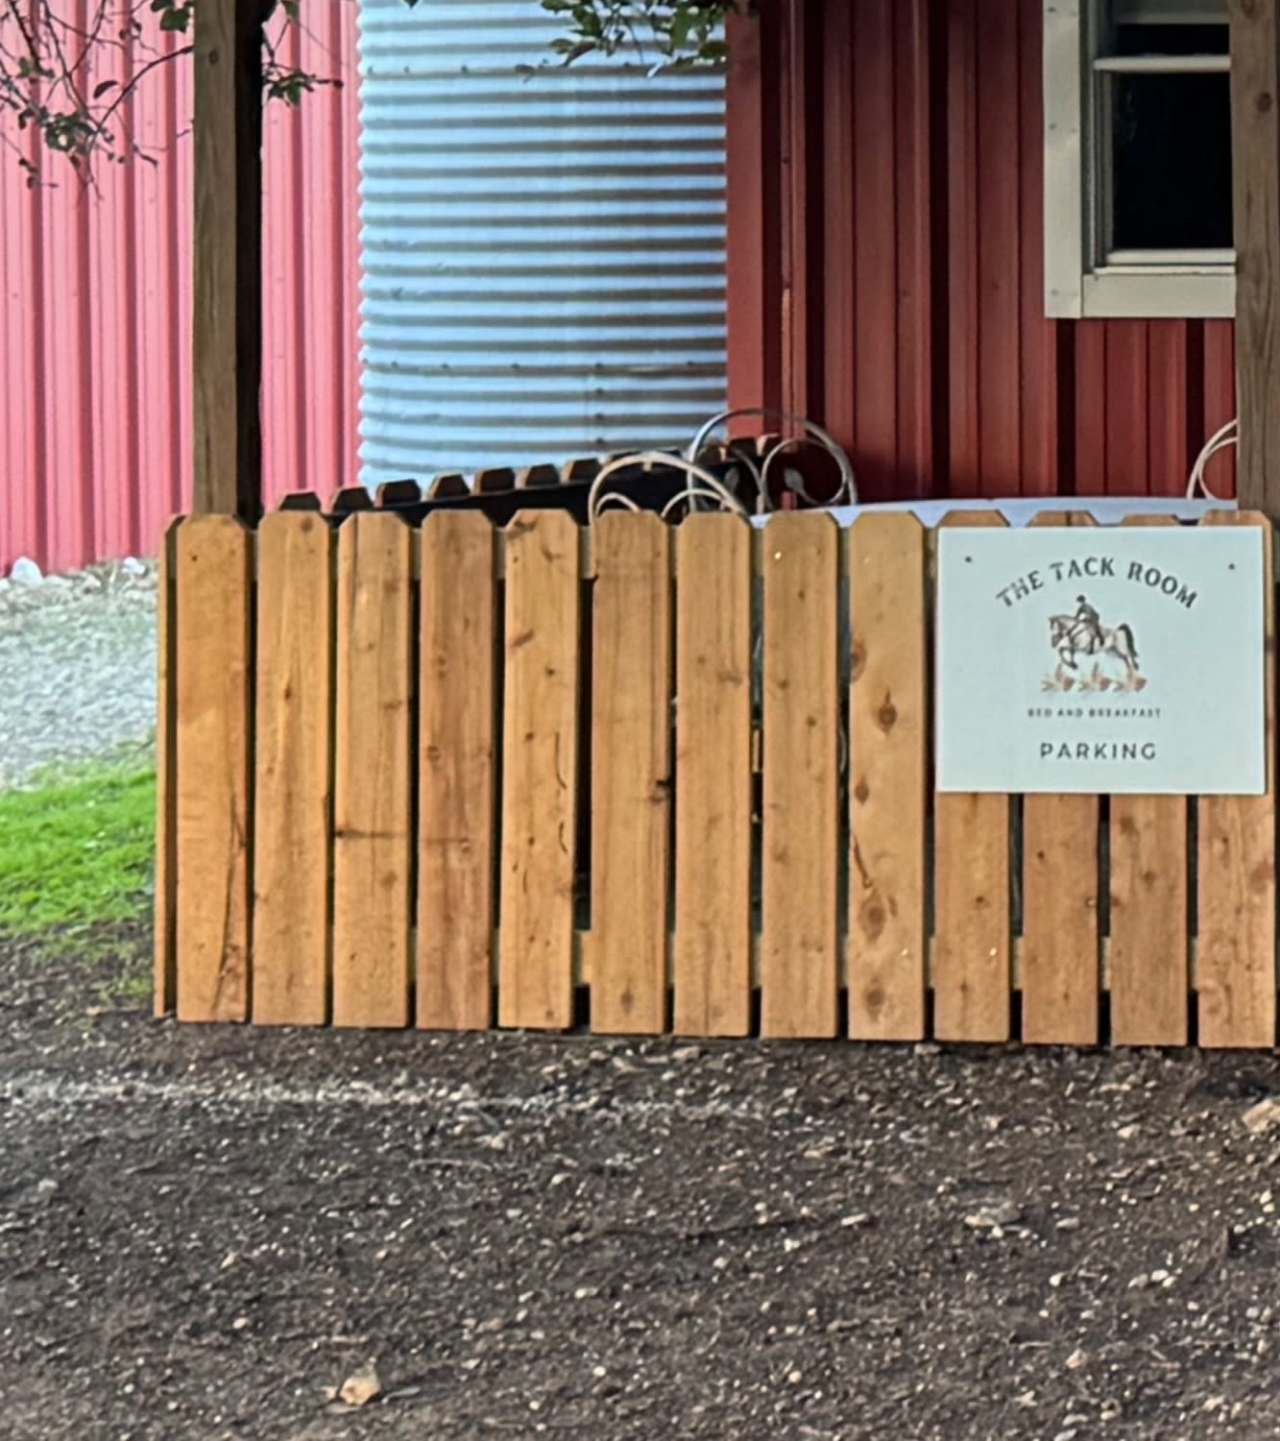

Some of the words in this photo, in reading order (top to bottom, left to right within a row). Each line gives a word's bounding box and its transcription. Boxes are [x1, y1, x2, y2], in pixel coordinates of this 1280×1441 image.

[996, 570, 1044, 607] THE
[1050, 557, 1115, 581] TACK
[1127, 561, 1198, 608] ROOM
[1028, 708, 1052, 718] BED
[1058, 708, 1083, 718] AND
[1089, 708, 1162, 718] BREAKFAST
[1040, 743, 1156, 760] PARKING
